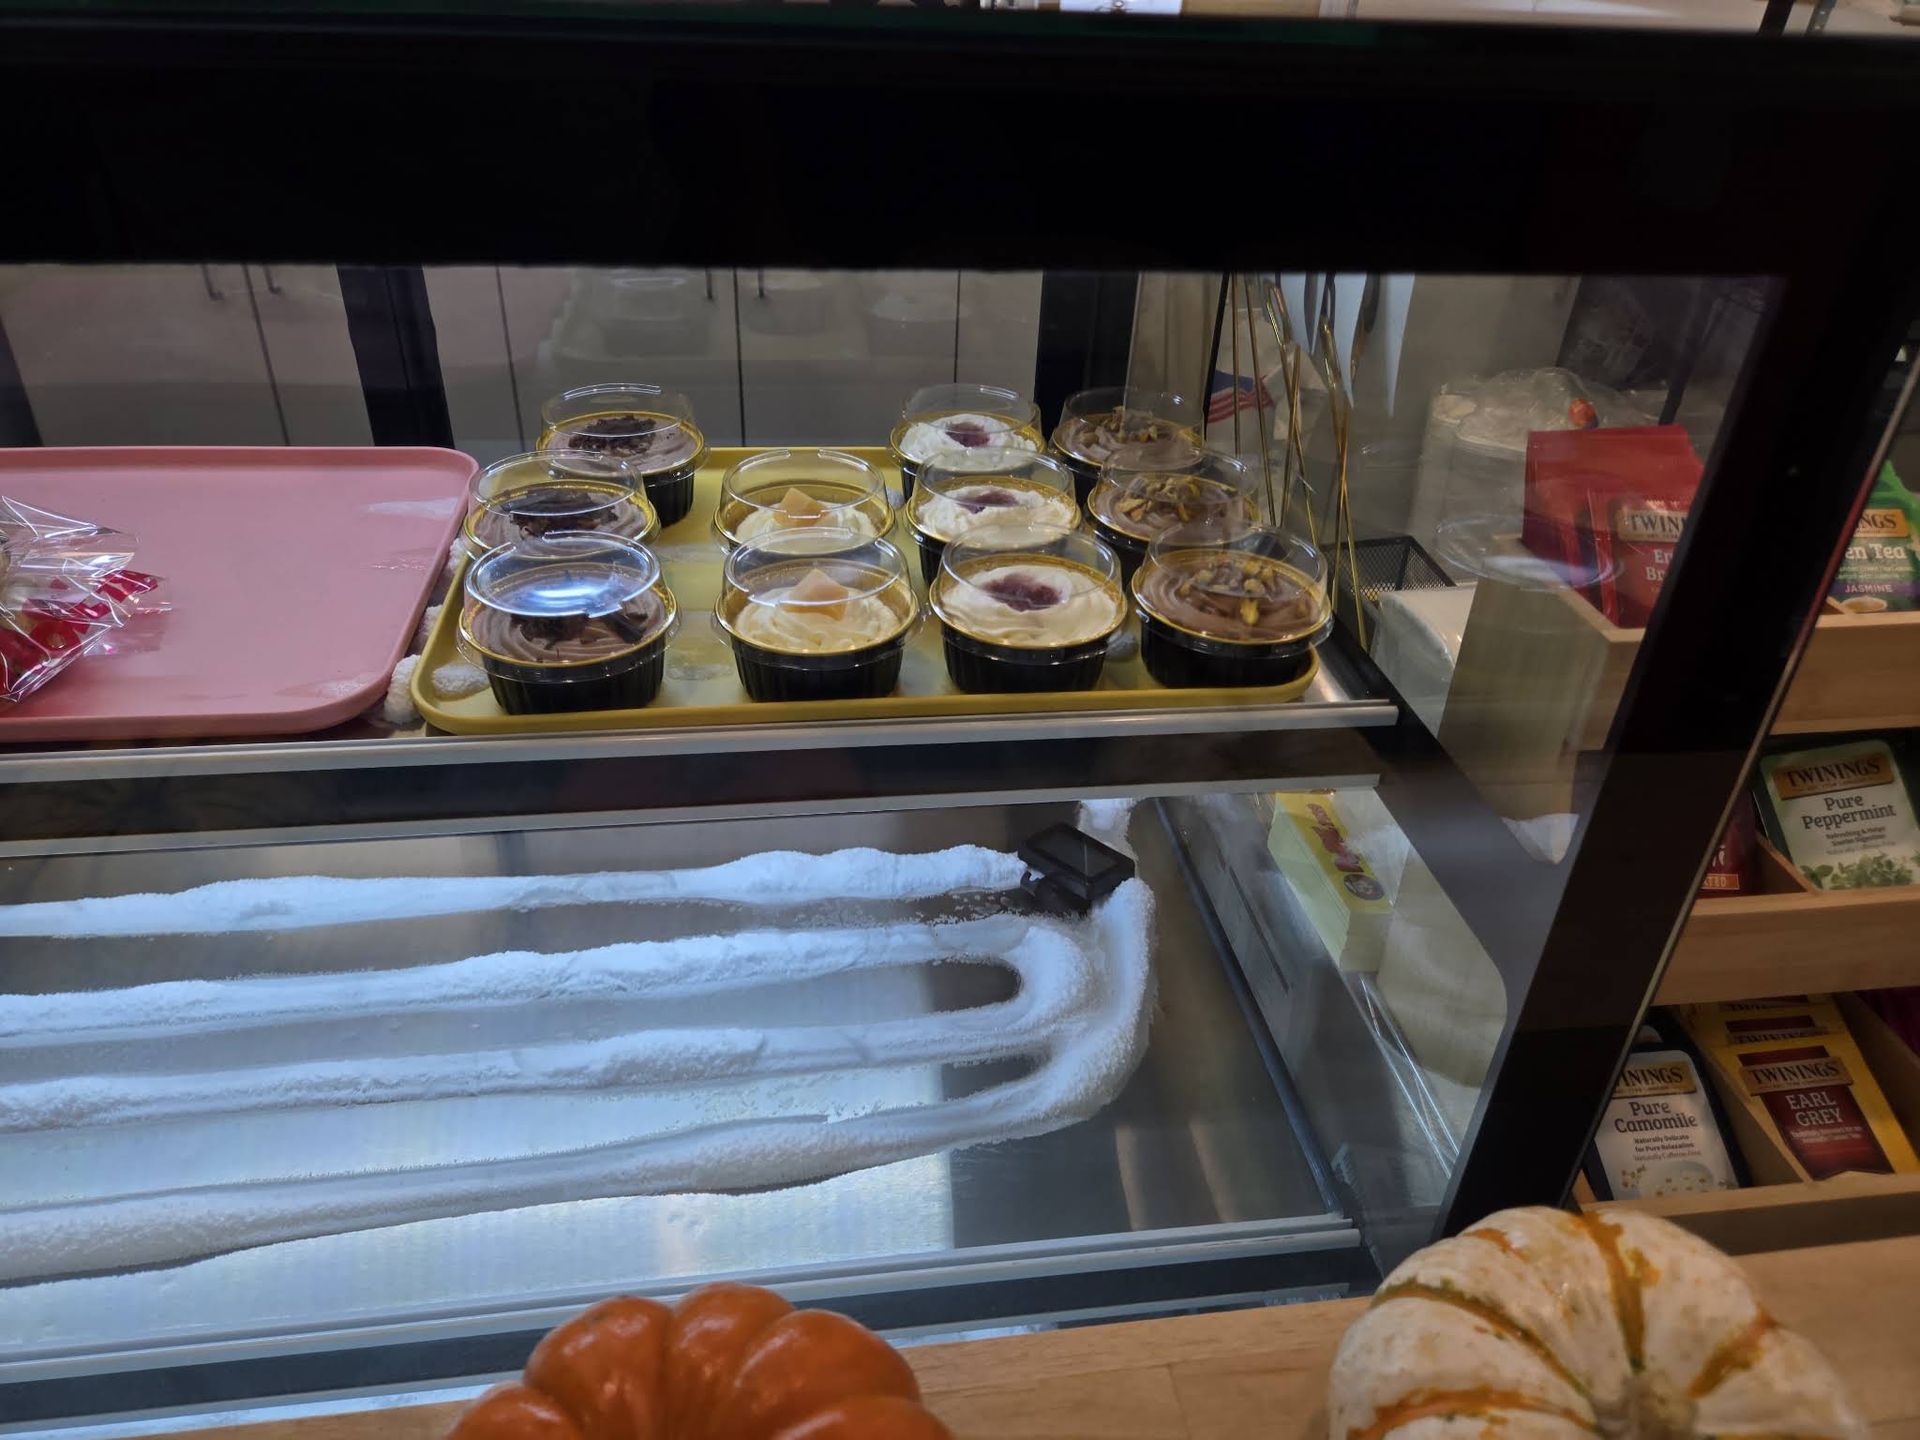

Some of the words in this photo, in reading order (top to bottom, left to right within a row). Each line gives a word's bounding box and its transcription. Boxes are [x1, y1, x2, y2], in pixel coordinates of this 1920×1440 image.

[1869, 543, 1907, 559] Tea
[1845, 584, 1893, 593] JASMINE
[1786, 759, 1880, 787] TWININGS
[1824, 794, 1863, 811] Pure
[1802, 804, 1897, 830] Peppermint
[1751, 1062, 1839, 1084] TWININGS
[1629, 1101, 1671, 1116] Pure
[1785, 1091, 1837, 1110] EARL
[1614, 1113, 1698, 1133] Camomile
[1796, 1108, 1844, 1127] GREY
